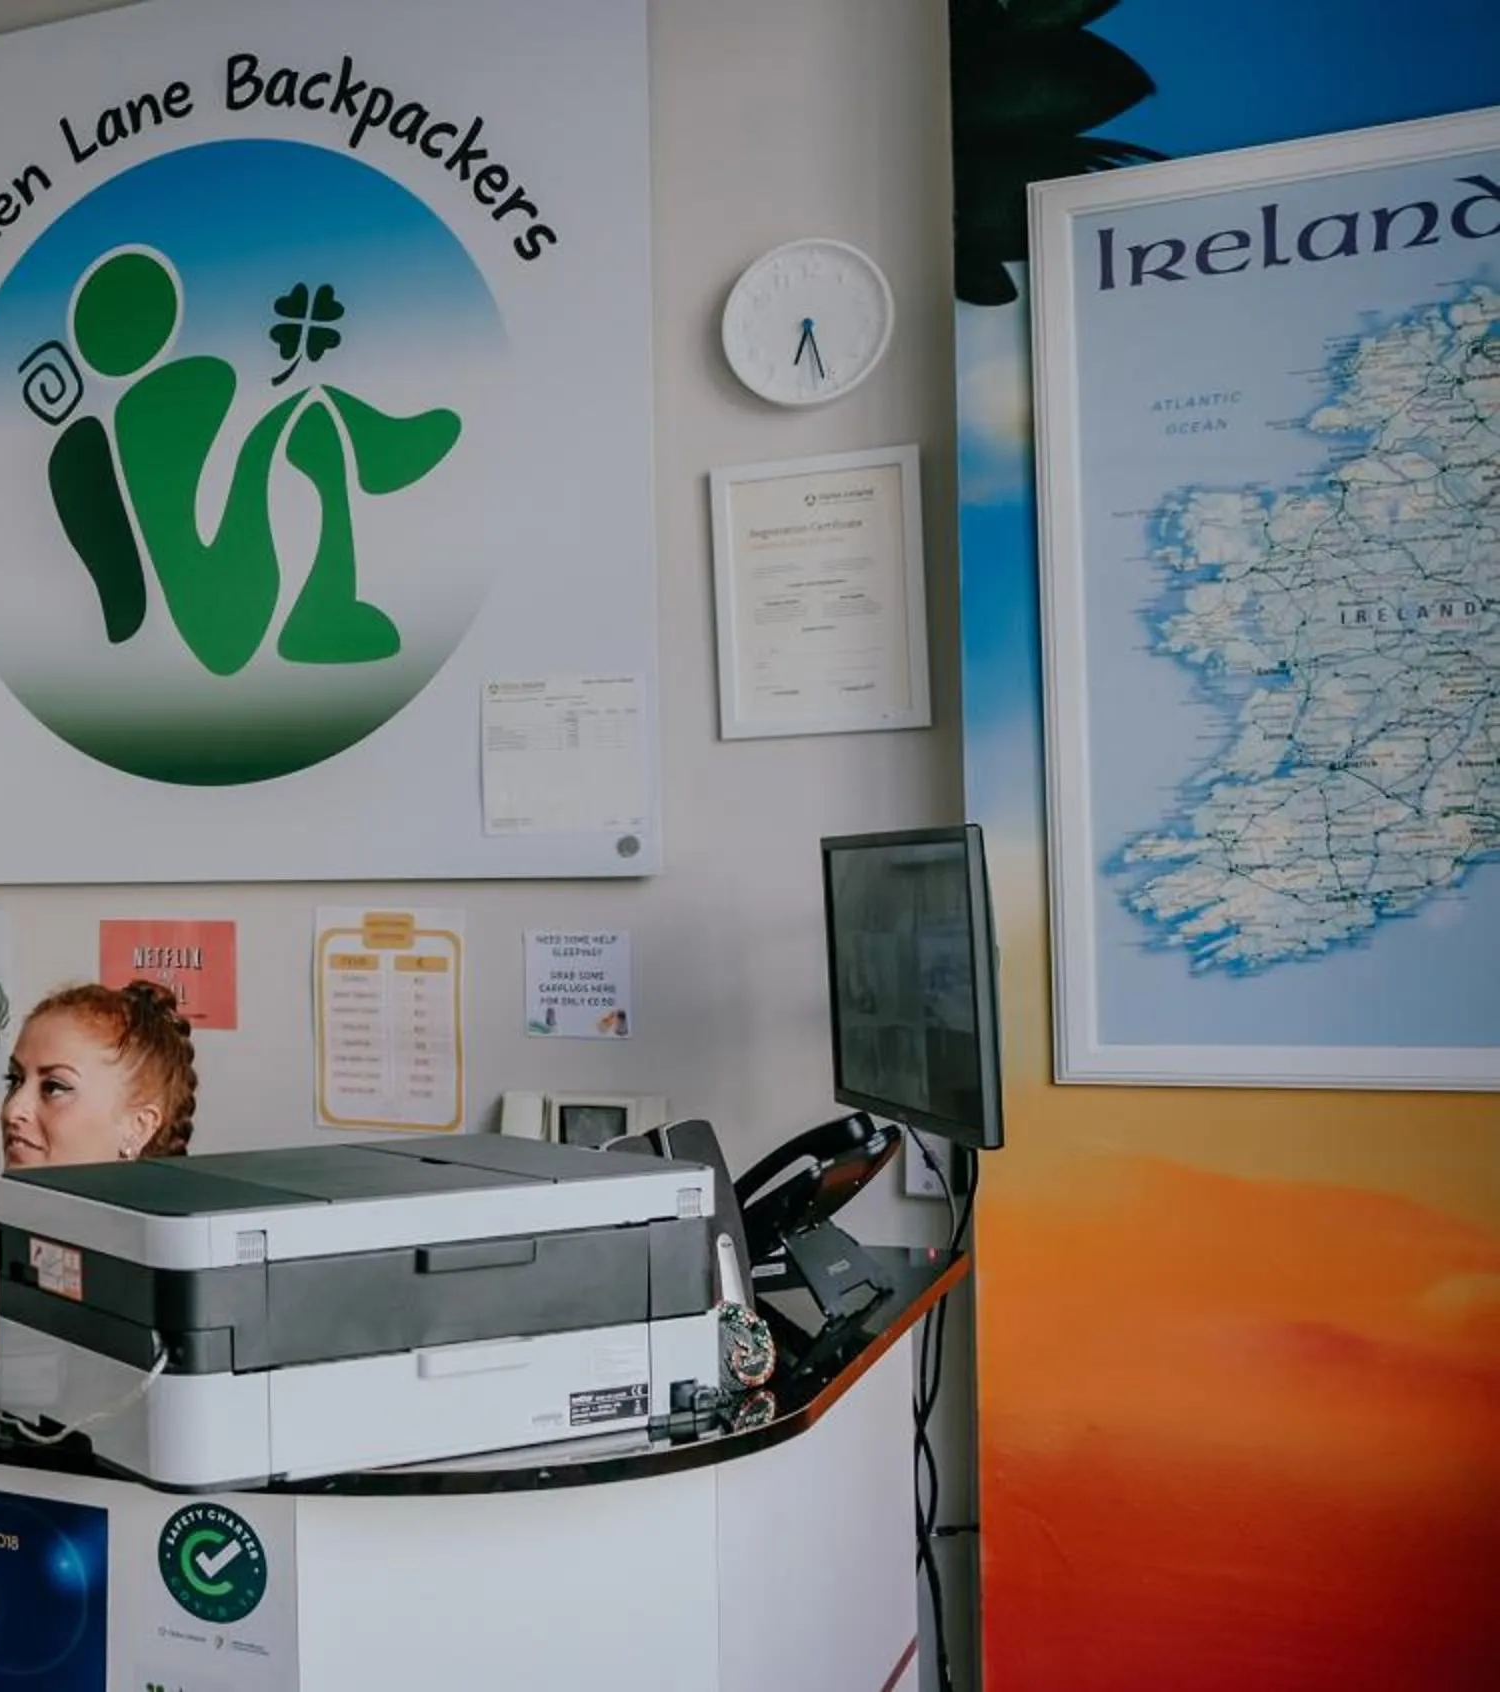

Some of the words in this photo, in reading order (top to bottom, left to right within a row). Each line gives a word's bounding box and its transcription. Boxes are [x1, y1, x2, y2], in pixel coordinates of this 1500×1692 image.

[59, 80, 193, 164] Lane
[226, 53, 558, 262] Backpackers
[1098, 175, 1500, 290] Ireland
[1150, 390, 1243, 412] ATLANTIC
[1165, 419, 1228, 436] OCEAN
[1340, 602, 1479, 625] IRELAND
[536, 935, 562, 944] NEED
[563, 935, 590, 945] SOME
[591, 935, 618, 945] HELP
[133, 947, 203, 970] NETFLIX
[550, 971, 576, 980] GRAB
[579, 971, 604, 981] SOME
[539, 983, 588, 993] EARPLUGS
[591, 984, 617, 994] HERE
[166, 1509, 203, 1546] SAFETY
[206, 1509, 260, 1561] CHARTER
